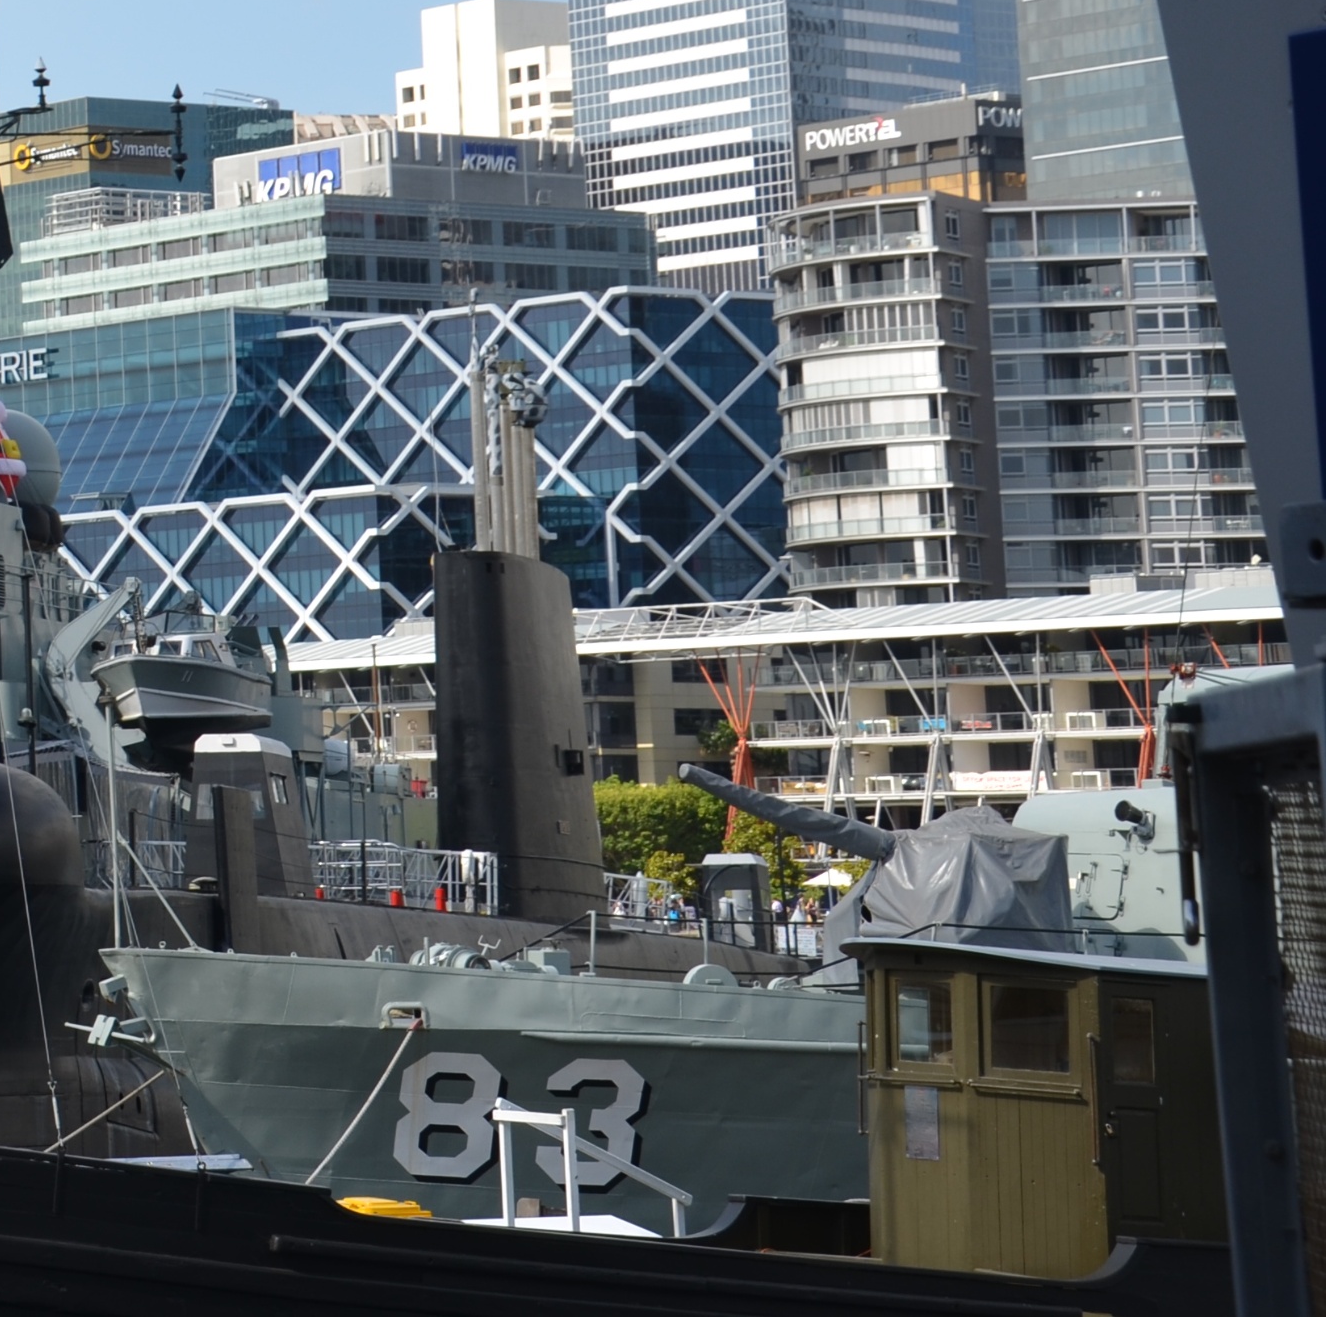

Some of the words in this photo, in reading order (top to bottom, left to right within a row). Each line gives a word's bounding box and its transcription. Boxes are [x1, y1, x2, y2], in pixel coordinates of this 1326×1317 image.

[111, 140, 172, 159] Symantec
[461, 153, 518, 174] KPMG
[393, 1052, 648, 1190] 83
